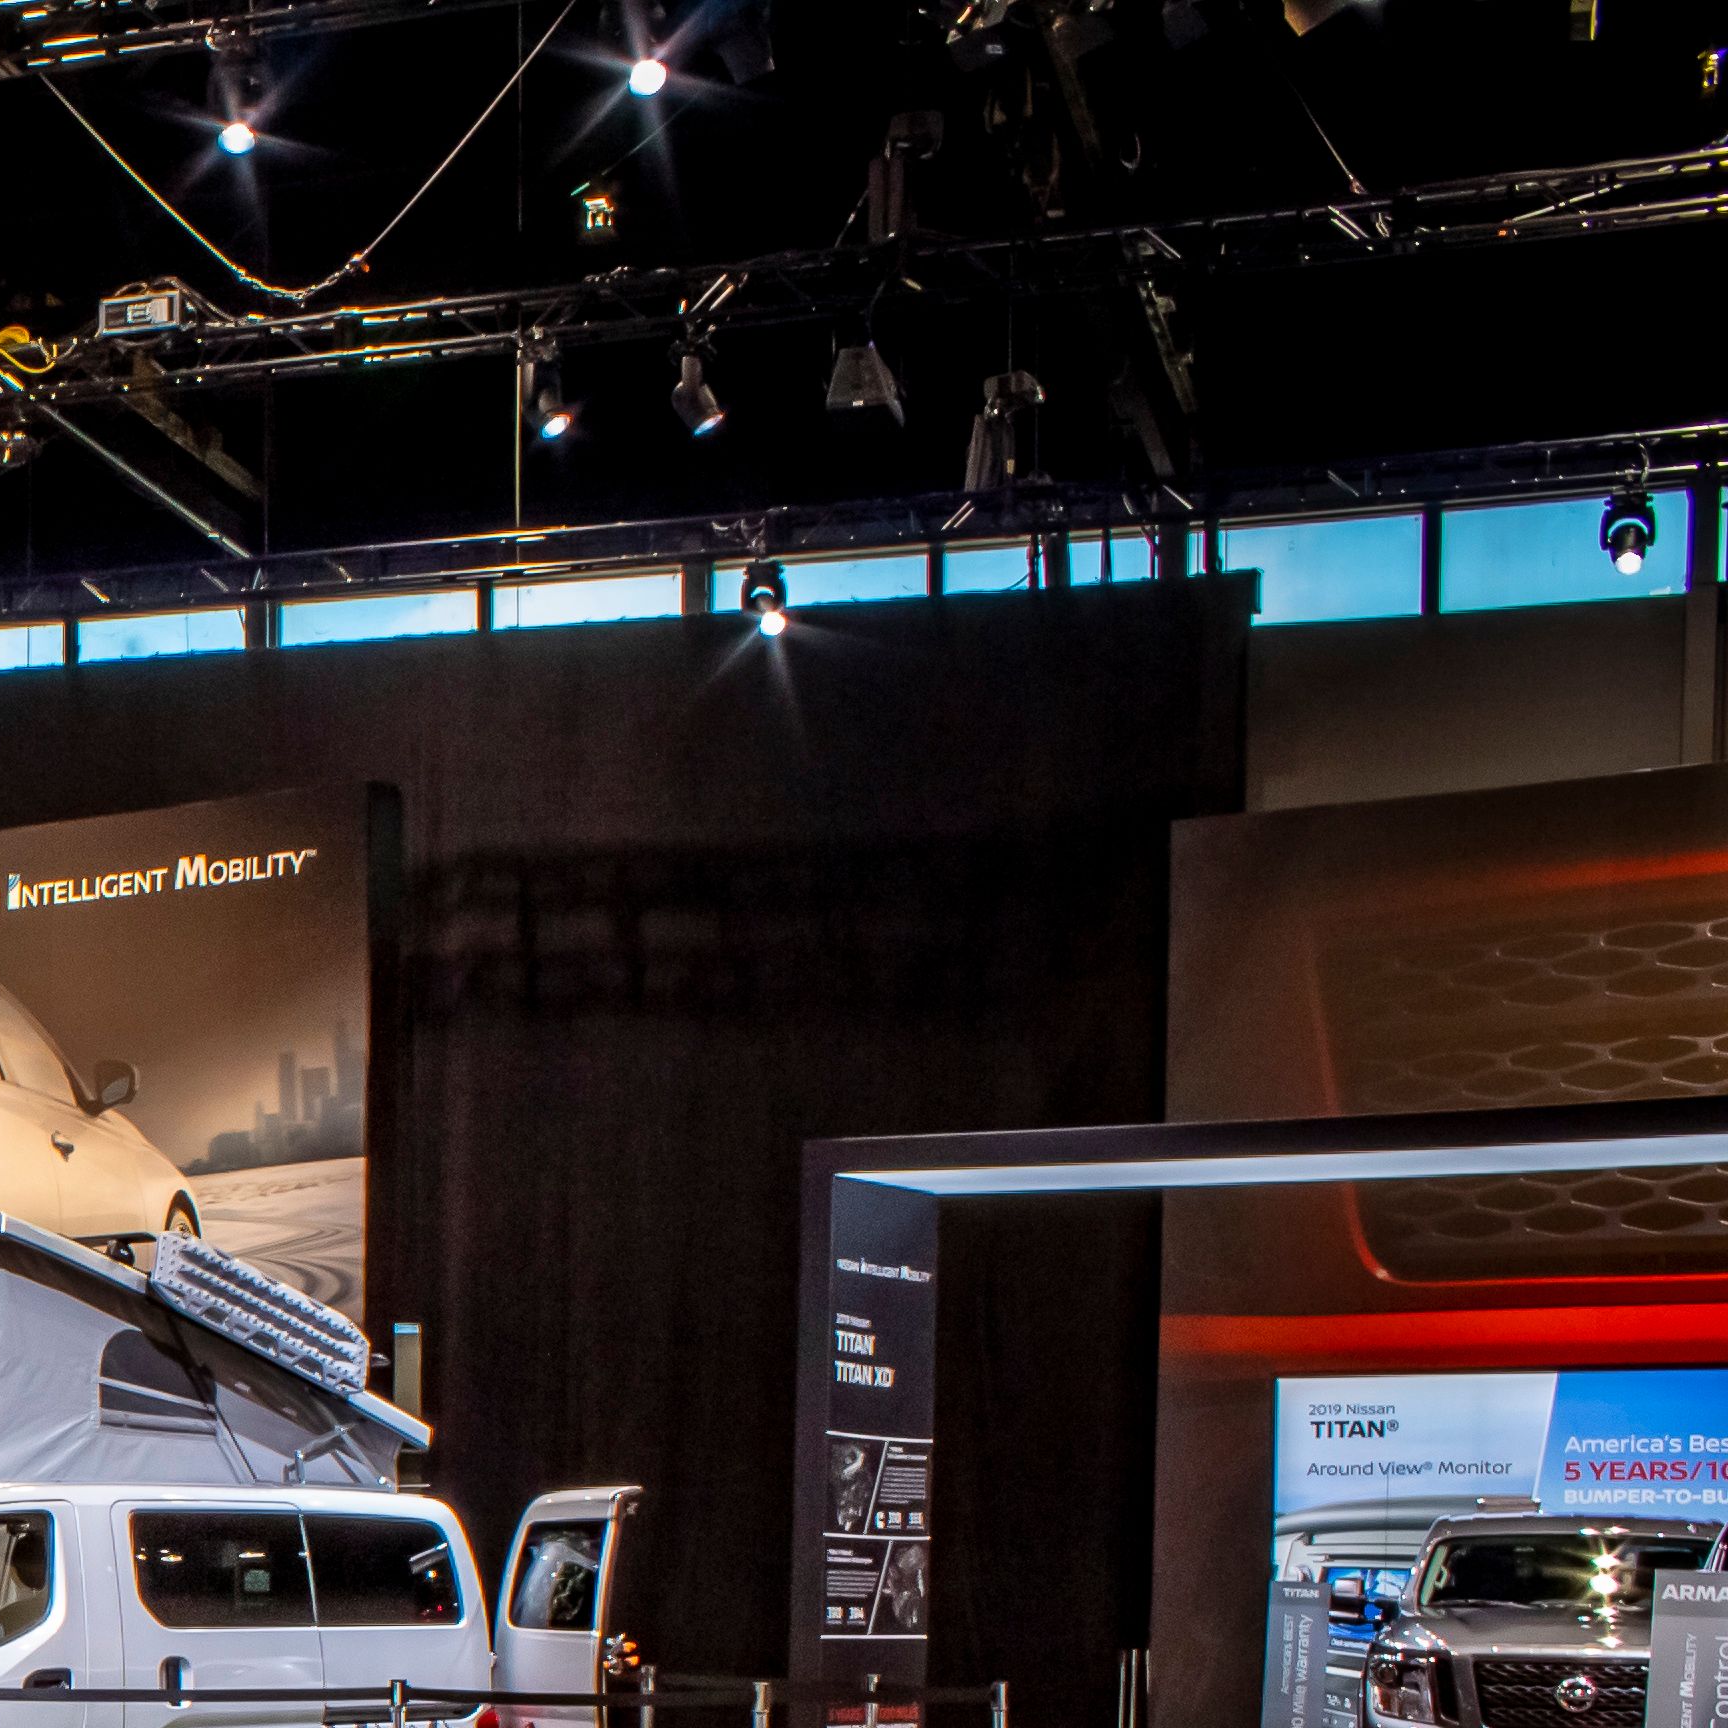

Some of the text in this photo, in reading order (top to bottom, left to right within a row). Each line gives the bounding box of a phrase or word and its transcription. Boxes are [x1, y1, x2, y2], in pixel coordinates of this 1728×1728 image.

[7, 867, 169, 911] INTELLIGENT
[834, 1330, 876, 1356] TITAN
[834, 1360, 874, 1387] TITAN
[1308, 1403, 1396, 1416] 2019 Nissan
[1564, 1434, 1682, 1454] America's
[1306, 1461, 1374, 1476] Around
[1438, 1460, 1513, 1476] Monitor
[1564, 1461, 1582, 1482] 5
[1282, 1588, 1320, 1599] TITAN
[1295, 1614, 1313, 1682] Warranty
